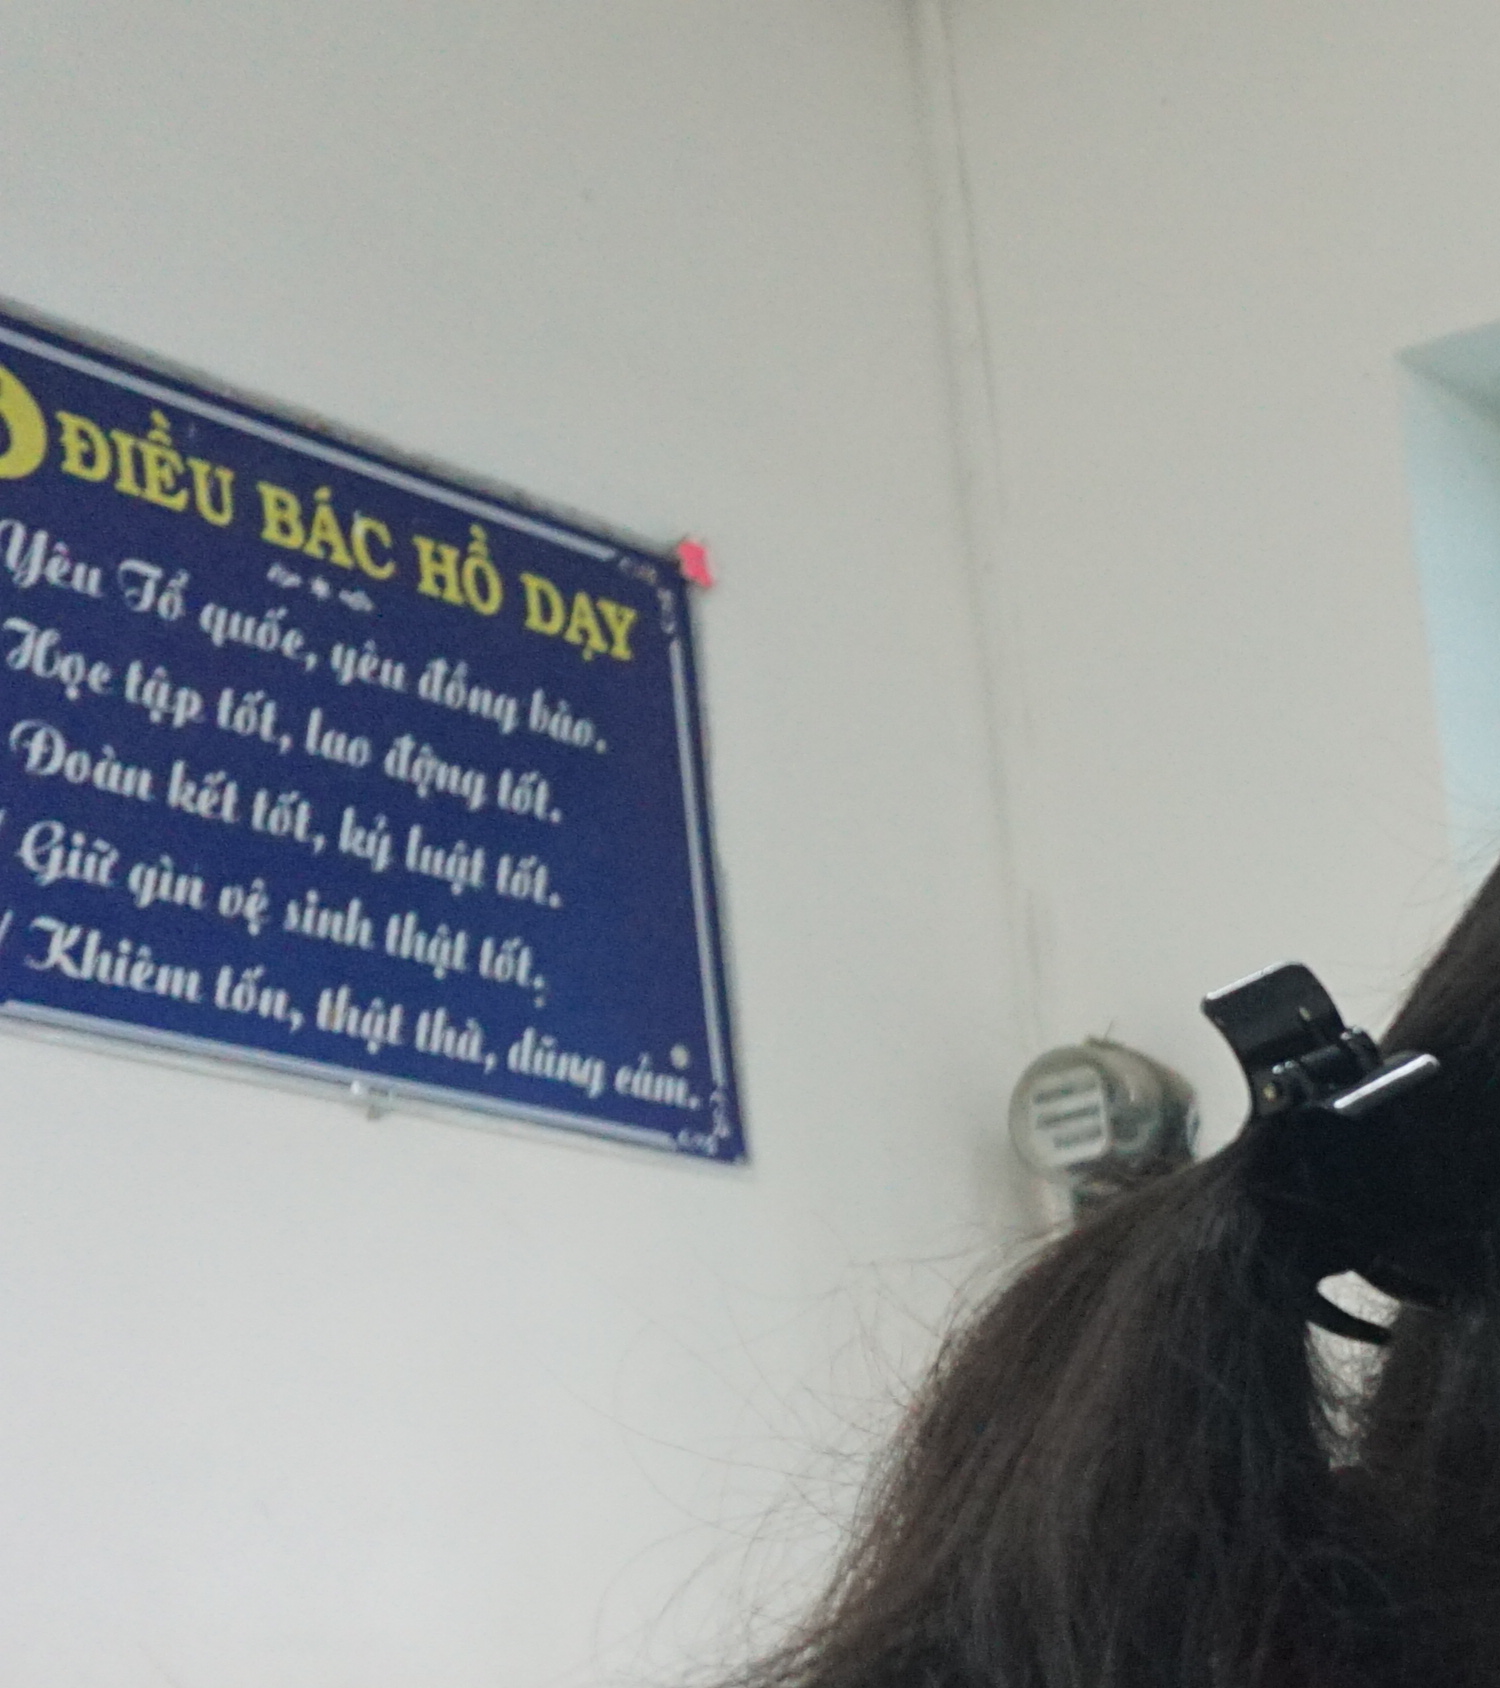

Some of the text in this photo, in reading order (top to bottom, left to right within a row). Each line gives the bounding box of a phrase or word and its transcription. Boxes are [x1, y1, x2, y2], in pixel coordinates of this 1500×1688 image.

[56, 409, 235, 527] ĐIỀU
[256, 481, 396, 580] BÁC
[412, 523, 503, 616] HỒ
[520, 572, 637, 662] DẠY
[305, 706, 373, 769] lao
[284, 888, 374, 950] sinh
[24, 914, 203, 1003] Khiêm
